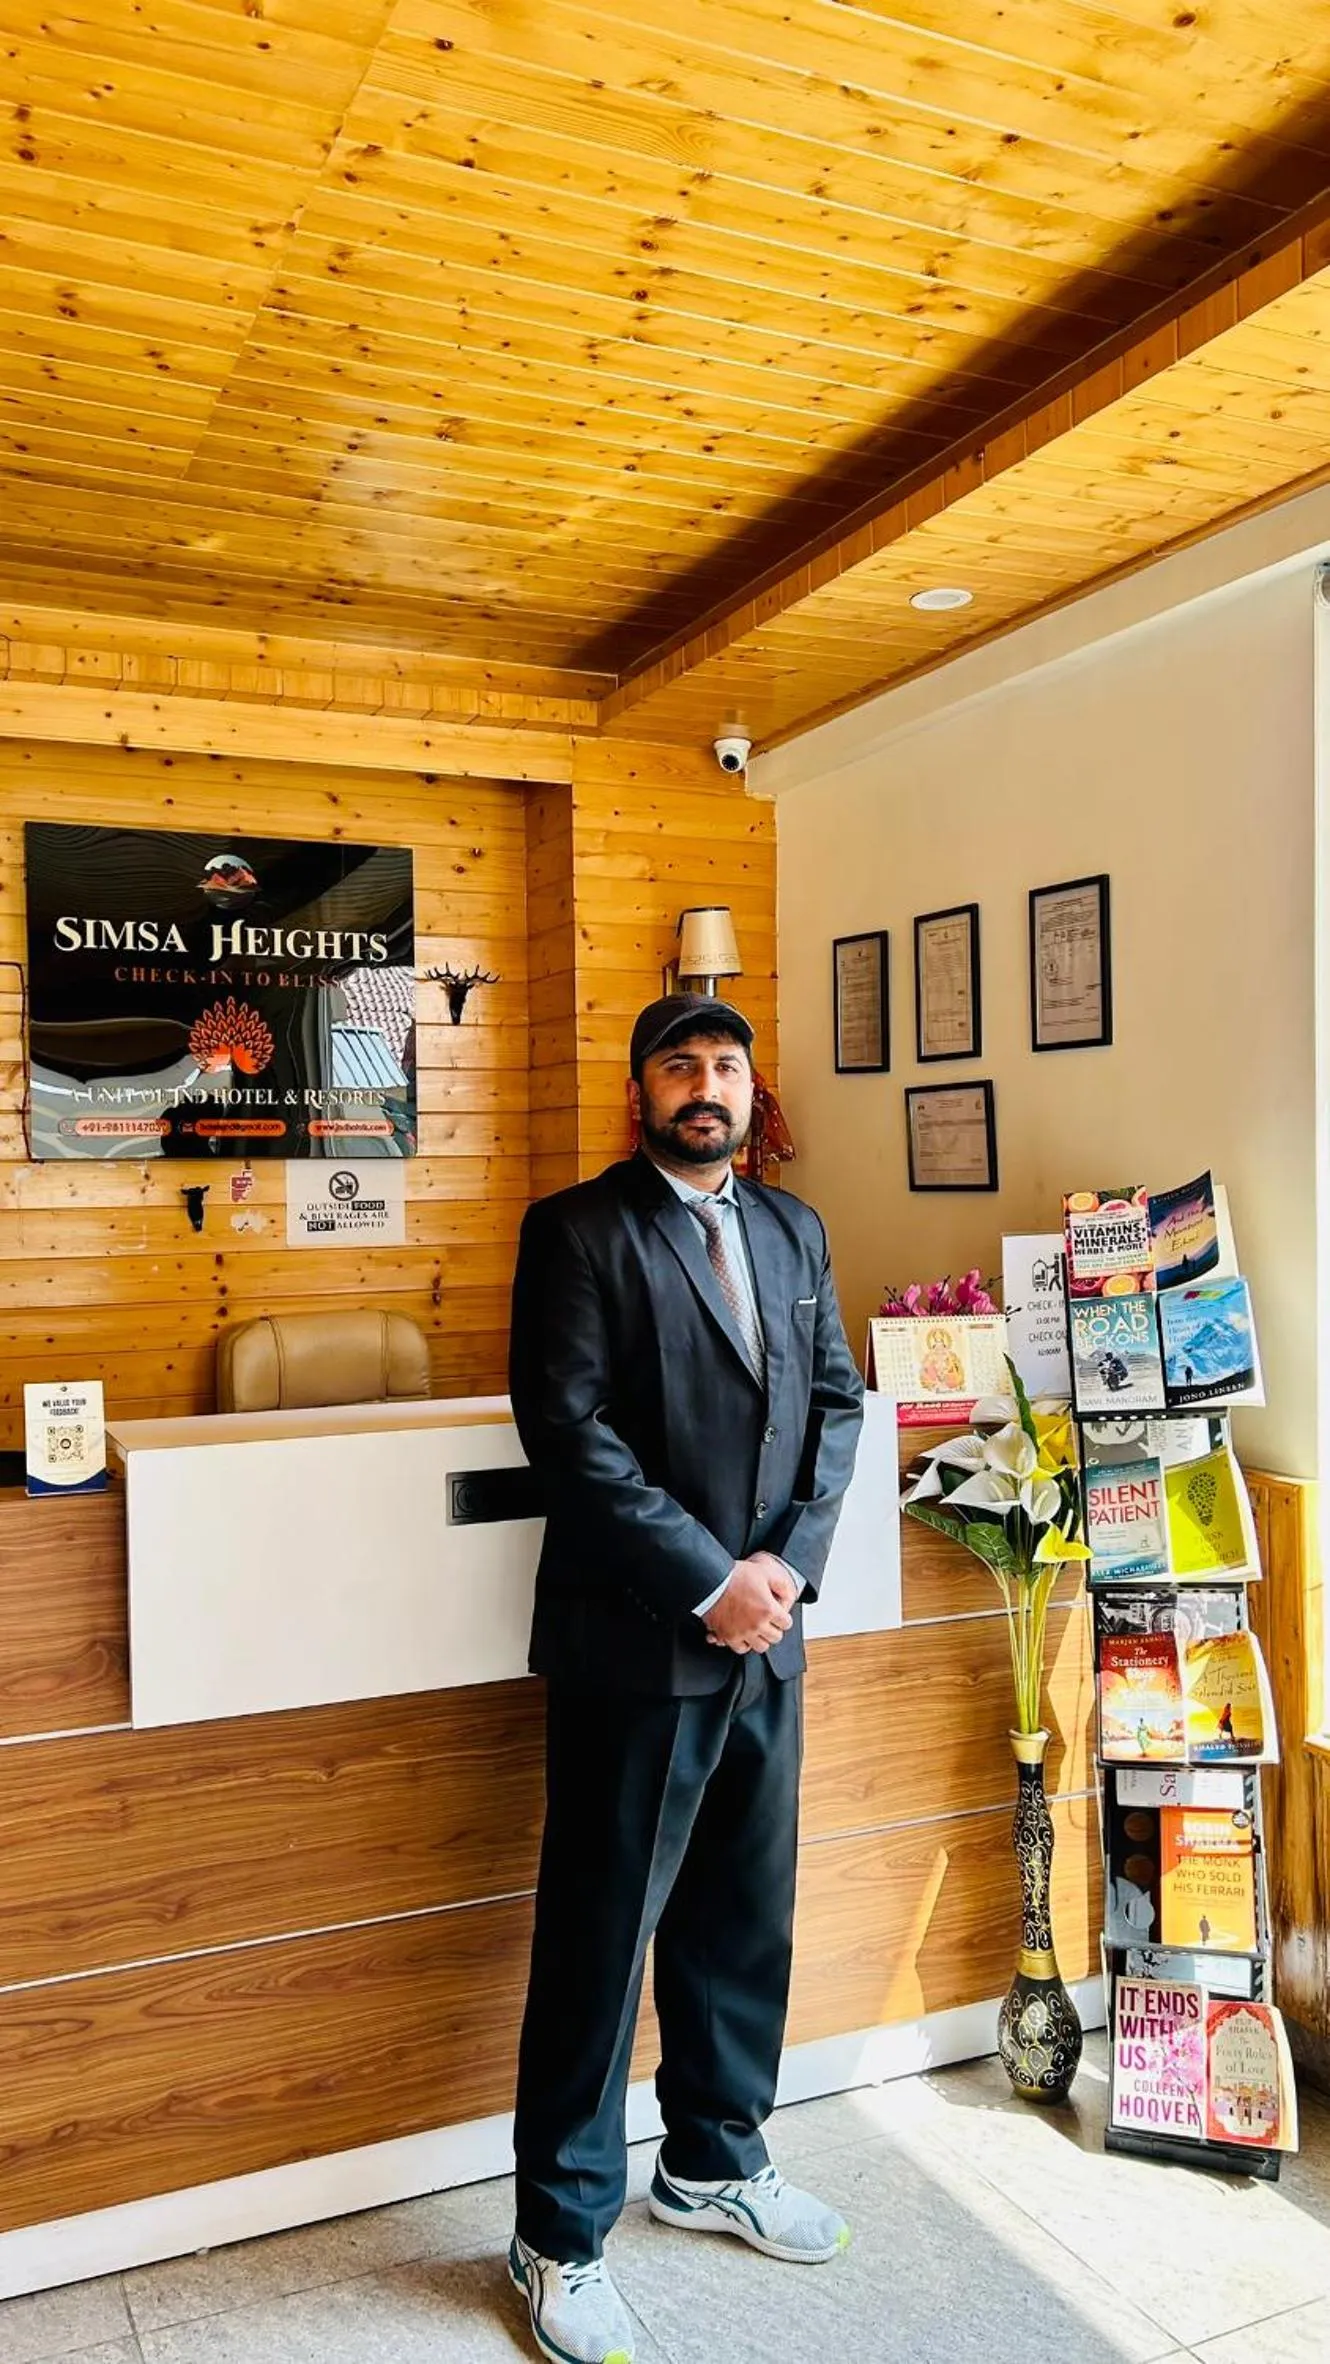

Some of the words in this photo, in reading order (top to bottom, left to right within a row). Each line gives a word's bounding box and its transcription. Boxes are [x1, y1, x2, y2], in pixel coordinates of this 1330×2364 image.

[54, 916, 189, 952] SIMSA
[208, 919, 389, 962] HEIGHTS
[114, 966, 234, 985] CHECK-IN
[243, 971, 271, 987] TO
[213, 1088, 279, 1105] HOTEL
[284, 1090, 298, 1105] &
[304, 1089, 386, 1109] RESORTS
[306, 1202, 350, 1211] OUTSIDE
[353, 1201, 384, 1210] FOOD
[311, 1211, 368, 1220] BEVERAGES
[371, 1211, 389, 1219] ARE
[308, 1222, 335, 1231] NOT
[337, 1221, 385, 1229] ALLOWED
[1074, 1223, 1146, 1238] VITAMINS,
[1074, 1232, 1147, 1248] MINERALS,
[1027, 1300, 1053, 1311] CHECK
[1073, 1304, 1117, 1318] WHEN
[1122, 1300, 1147, 1314] THE
[1074, 1313, 1150, 1336] ROAD
[1088, 1480, 1159, 1506] SILENT
[1089, 1501, 1160, 1526] PATIENT
[1134, 1647, 1148, 1655] The
[1111, 1656, 1169, 1667] Stationery
[1176, 1854, 1199, 1866] THE
[1203, 1856, 1241, 1868] MONK
[1177, 1868, 1206, 1880] WHO
[1209, 1870, 1241, 1883] SOLD
[1173, 1883, 1194, 1894] HIS
[1197, 1884, 1245, 1897] FERRARI
[1120, 1987, 1138, 2011] IT
[1145, 1990, 1198, 2018] ENDS
[1120, 2015, 1174, 2040] WITH
[1119, 2044, 1146, 2071] US
[1134, 2079, 1185, 2098] COLLEEN
[1119, 2093, 1198, 2126] HOOVER
